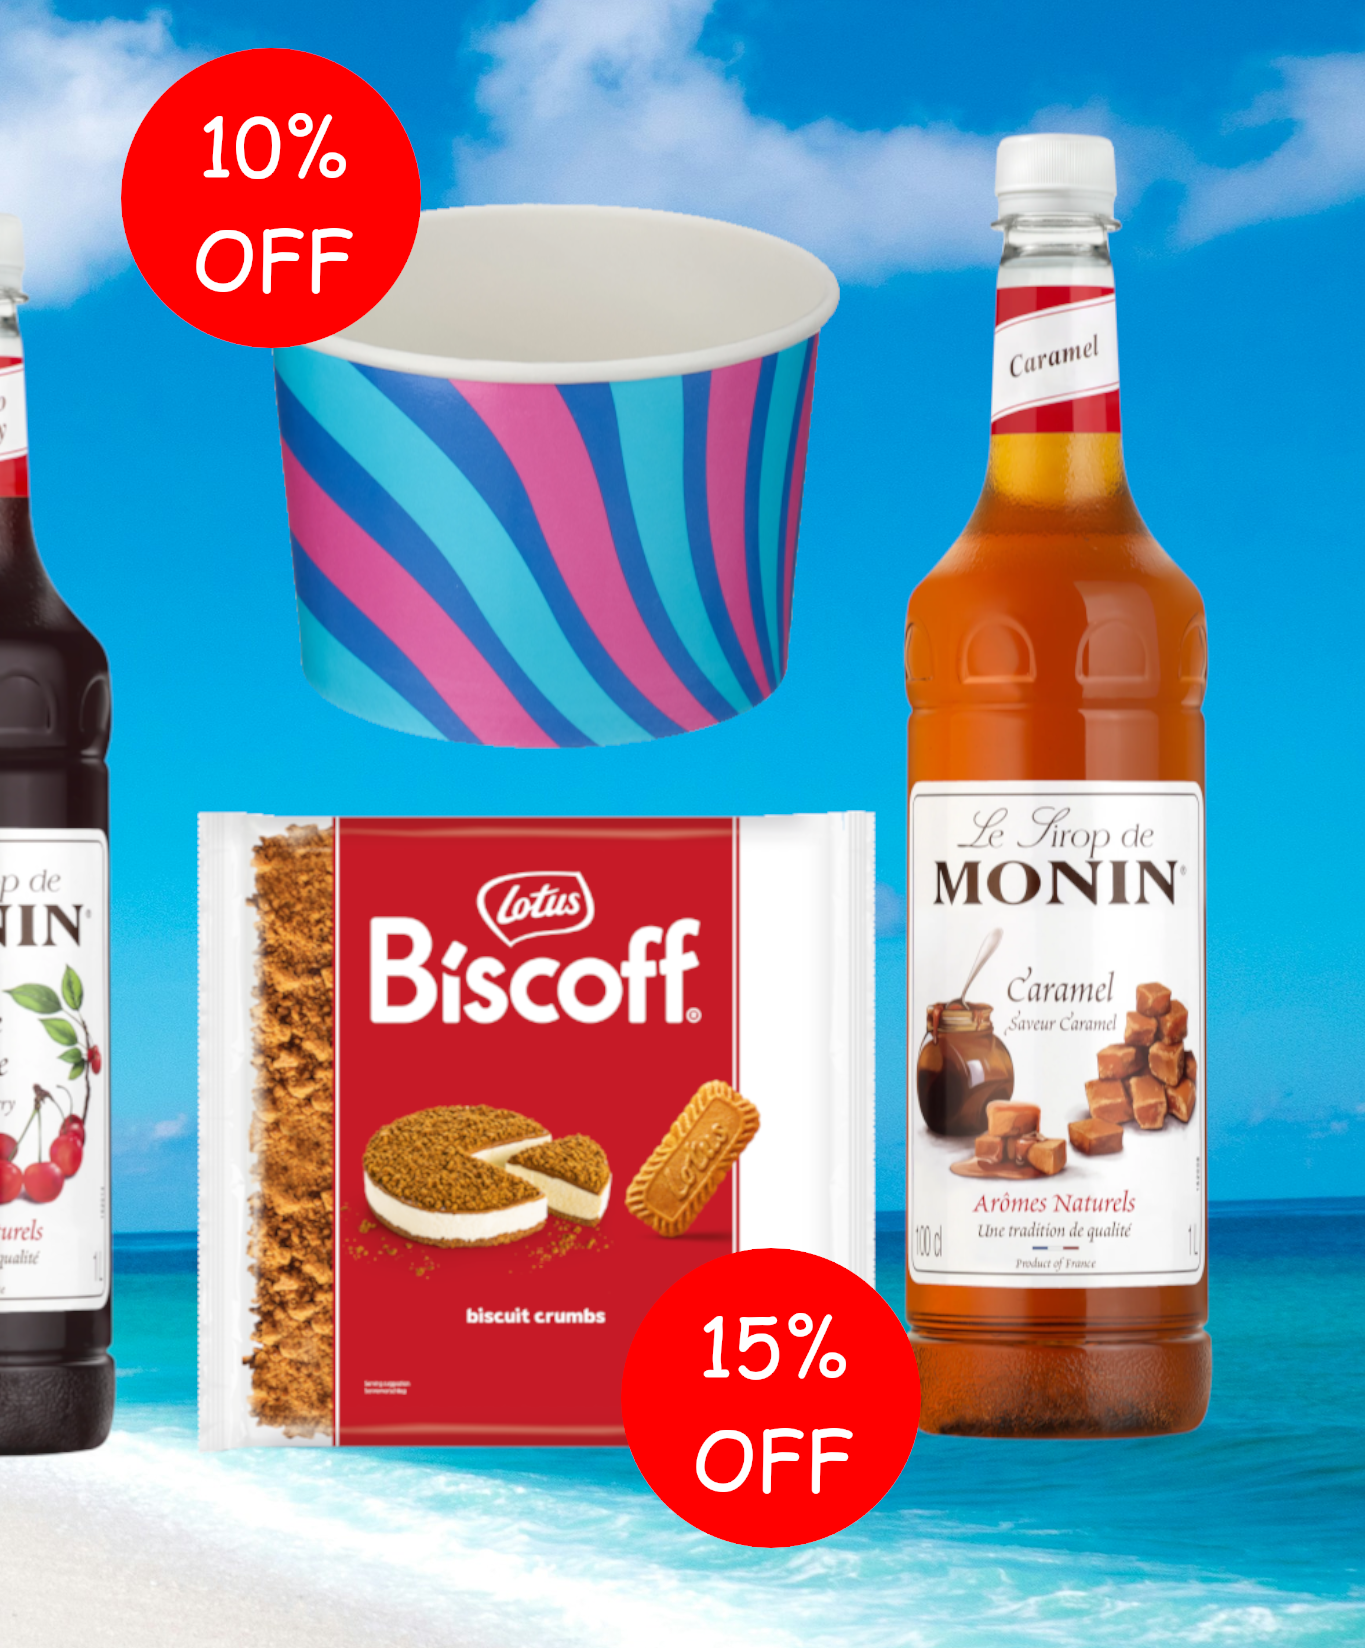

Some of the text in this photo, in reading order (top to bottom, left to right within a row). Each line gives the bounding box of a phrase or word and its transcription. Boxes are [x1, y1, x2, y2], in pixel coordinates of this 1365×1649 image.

[1009, 333, 1099, 378] Caramel
[957, 806, 1154, 859] Le Sirop de
[29, 869, 61, 893] de
[933, 860, 1178, 906] MONIN
[496, 883, 582, 925] Lotus
[370, 916, 701, 1024] Biscoff
[1007, 966, 1115, 1003] Caramel
[1004, 1010, 1117, 1036] Saveur Caramel
[973, 1189, 1136, 1213] Arômes Naturels
[977, 1220, 1132, 1243] Une tradition de qualité
[1016, 1257, 1096, 1271] Product of France
[466, 1306, 606, 1324] biscuit crumbs
